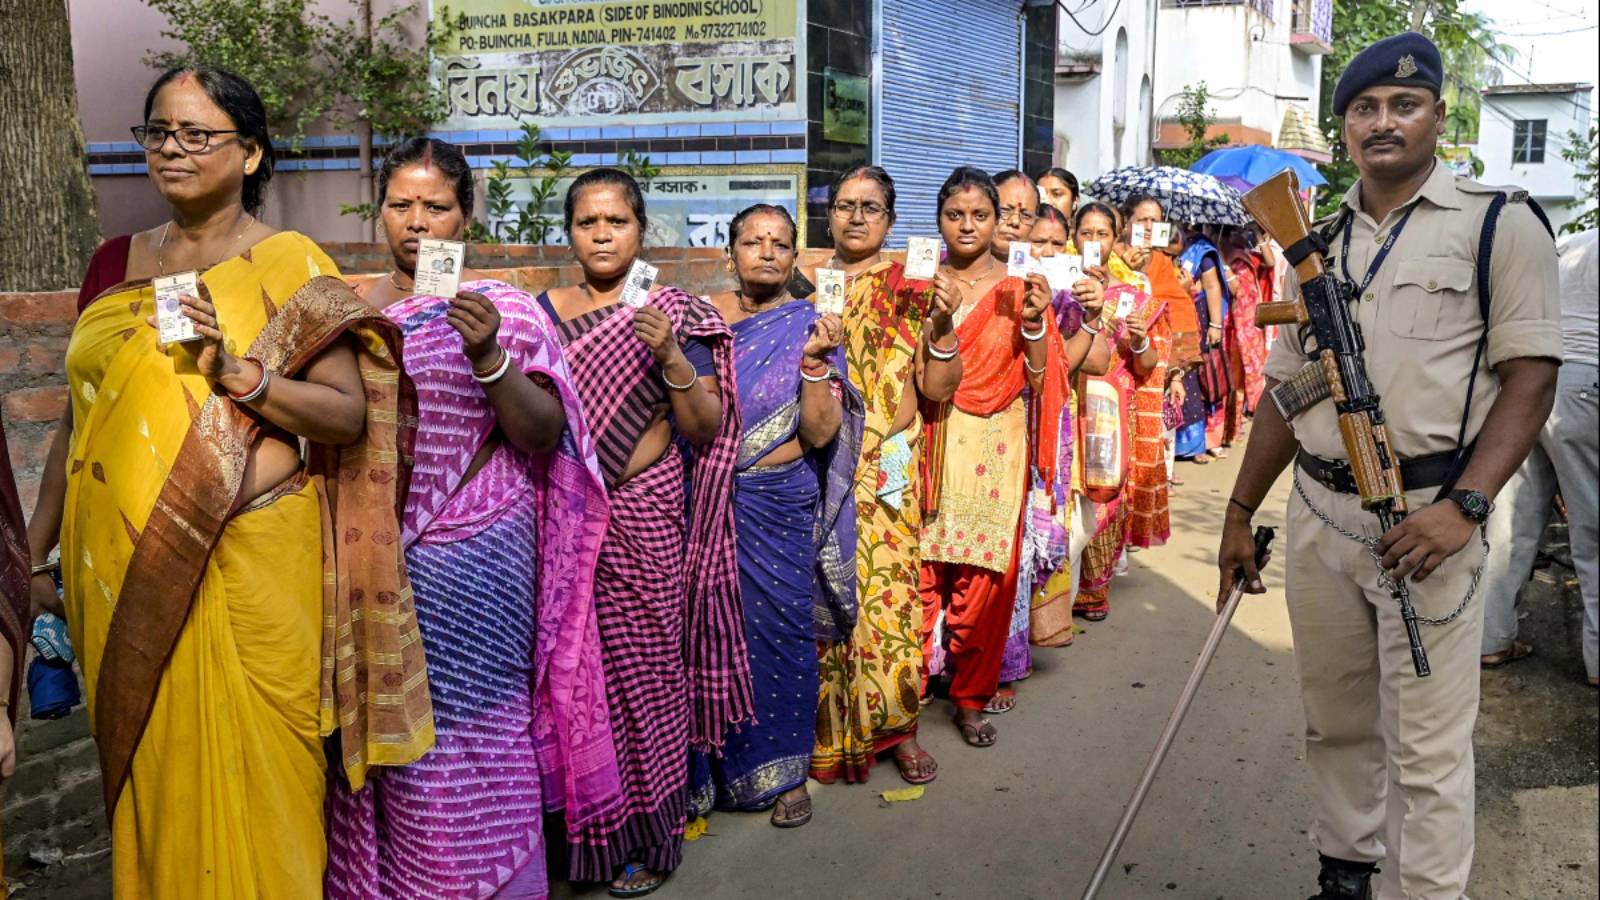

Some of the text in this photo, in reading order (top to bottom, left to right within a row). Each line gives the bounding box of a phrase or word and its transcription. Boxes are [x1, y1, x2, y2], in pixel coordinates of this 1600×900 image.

[513, 8, 595, 27] BASAKPARA
[600, 6, 633, 27] (SIDE
[635, 5, 650, 21] OF
[653, 1, 702, 19] BINODINI
[611, 26, 676, 43] PIN-741402
[674, 54, 792, 104] বসাক
[653, 181, 699, 193] বসাক
